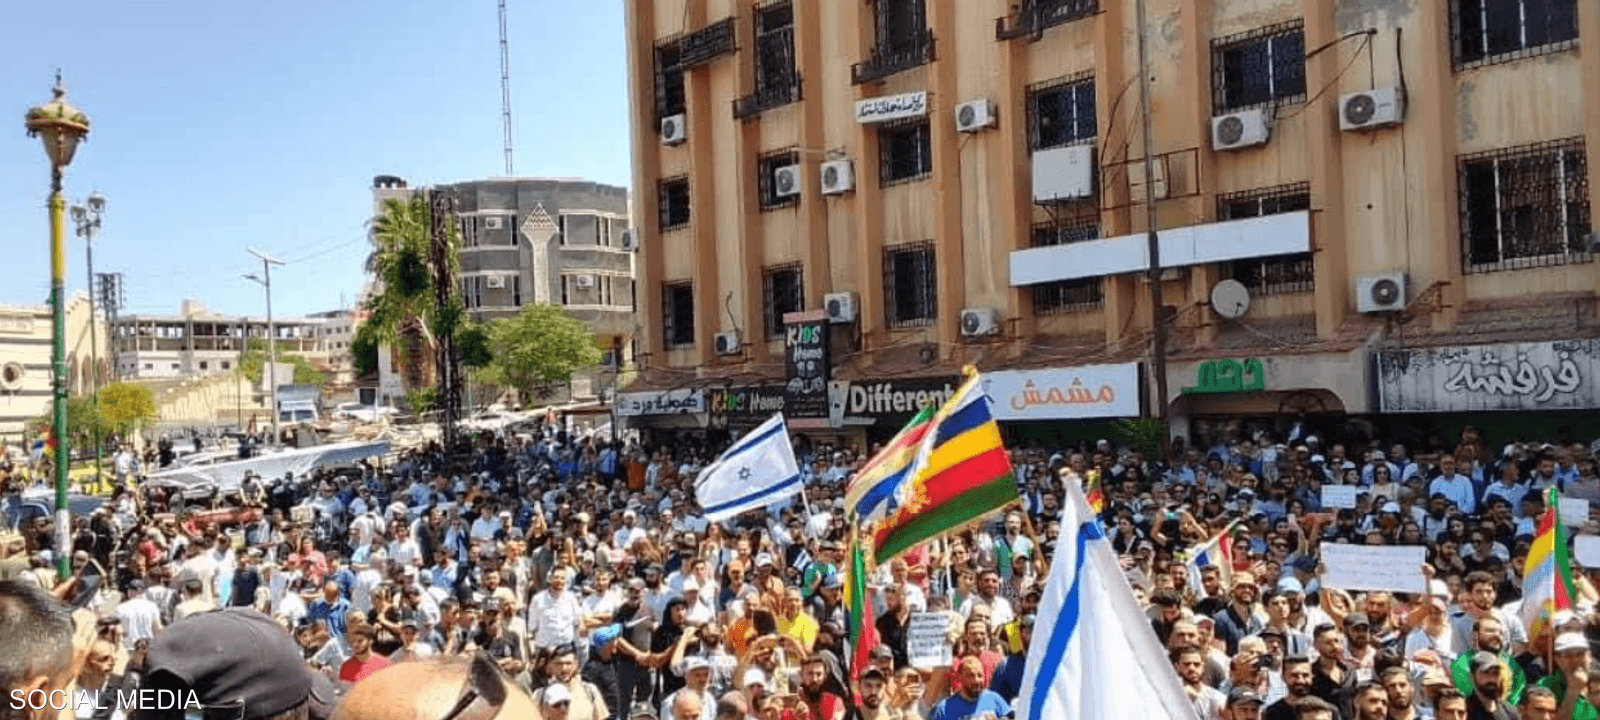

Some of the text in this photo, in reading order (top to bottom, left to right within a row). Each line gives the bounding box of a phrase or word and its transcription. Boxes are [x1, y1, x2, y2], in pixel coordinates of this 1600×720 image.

[749, 390, 785, 414] Home
[851, 382, 955, 414] Different
[1011, 377, 1115, 411] مشمش
